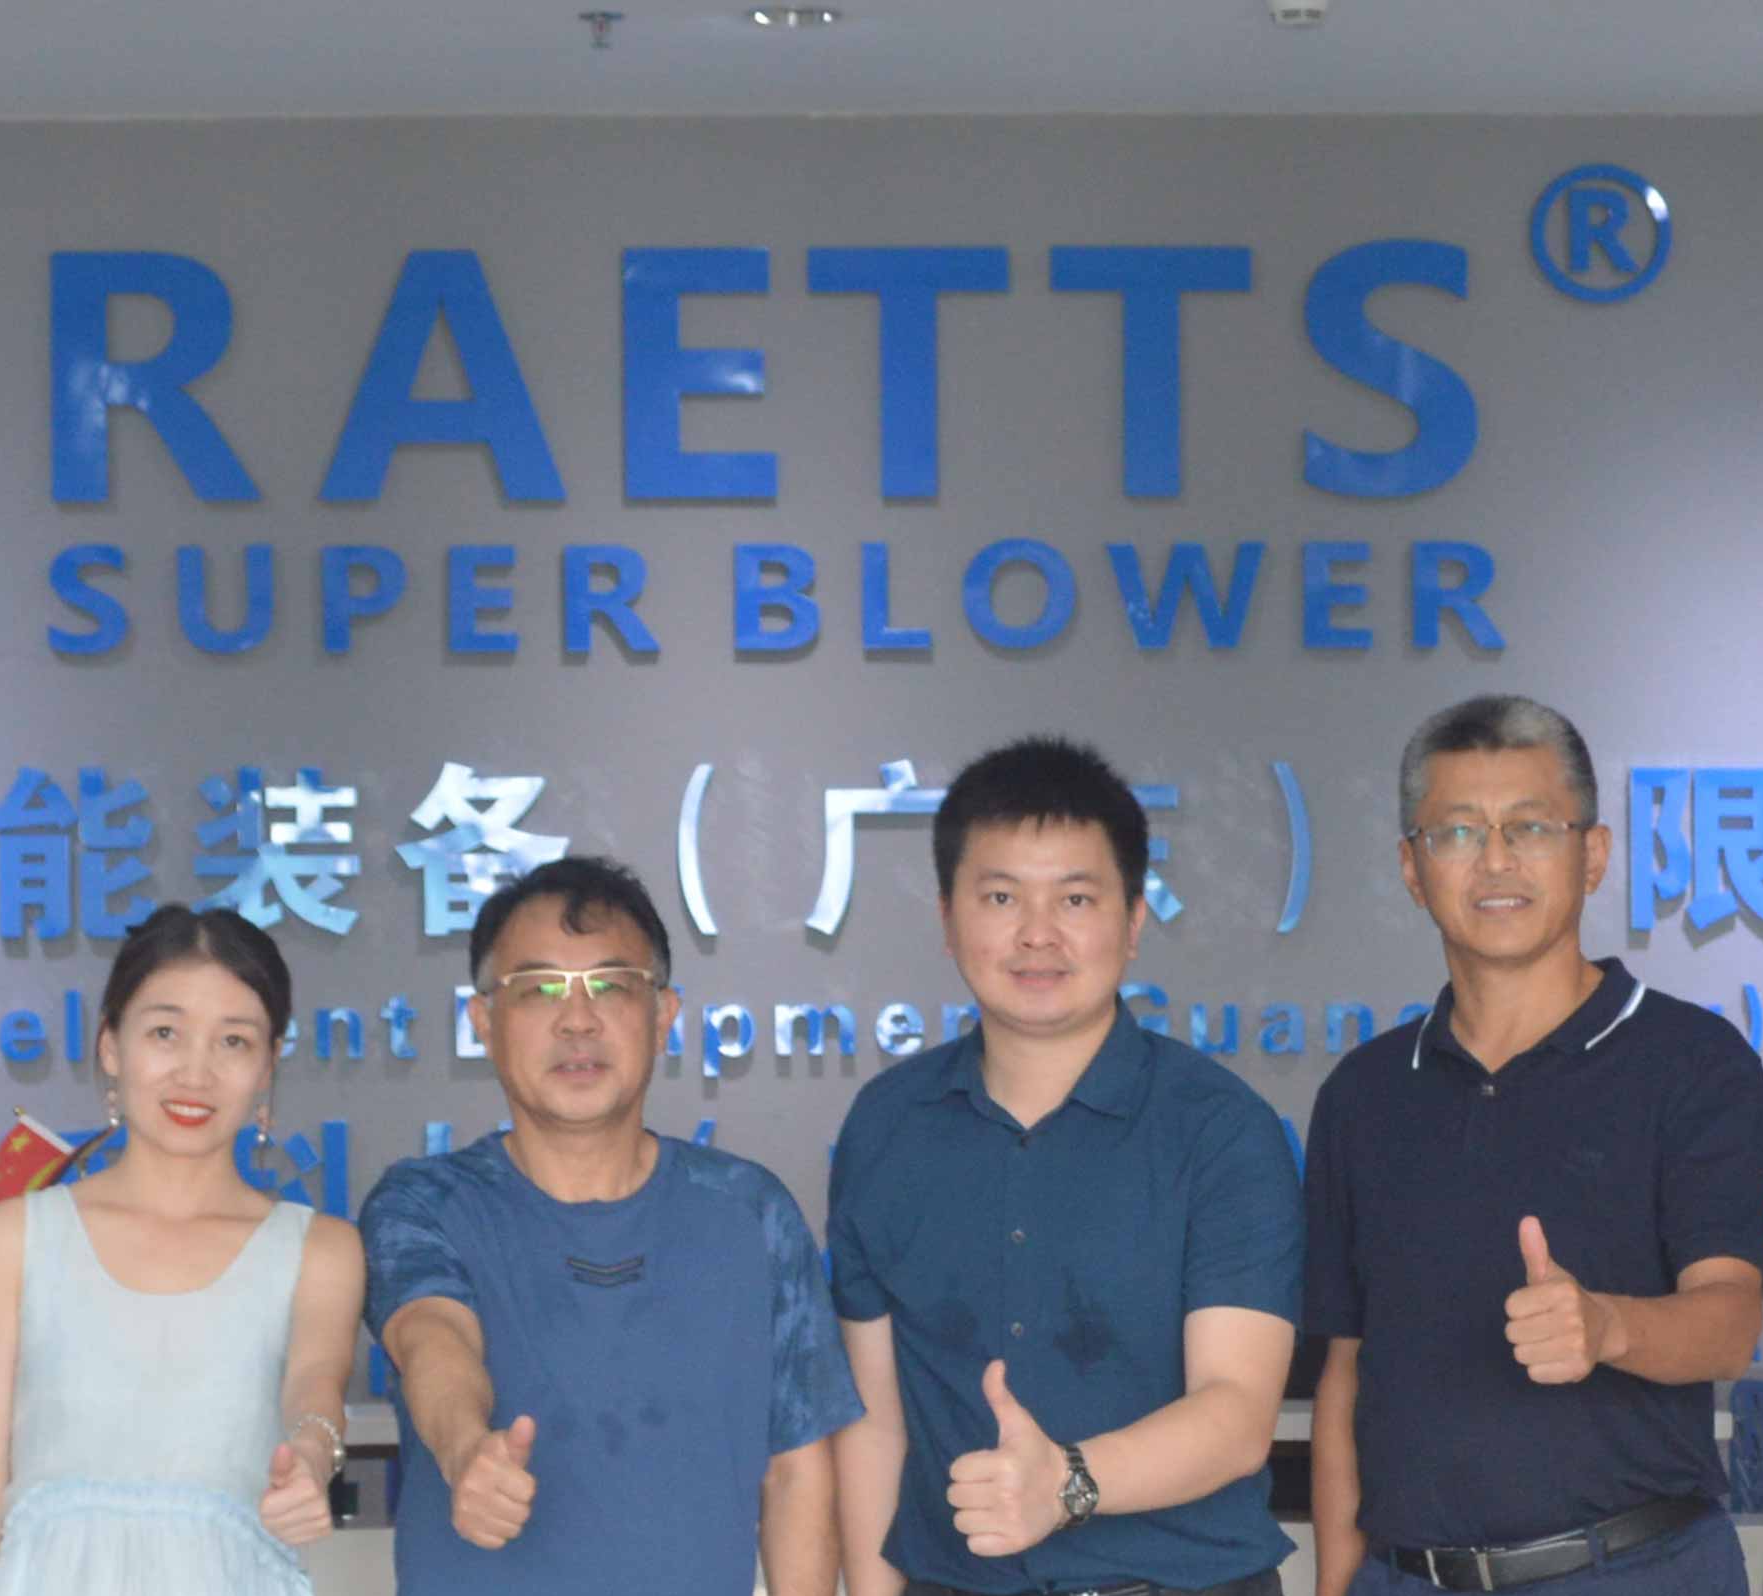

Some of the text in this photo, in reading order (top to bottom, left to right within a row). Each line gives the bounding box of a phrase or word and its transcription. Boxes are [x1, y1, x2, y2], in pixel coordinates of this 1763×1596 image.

[47, 237, 1481, 504] RAETTS
[45, 536, 1507, 657] SUPER BLOWER
